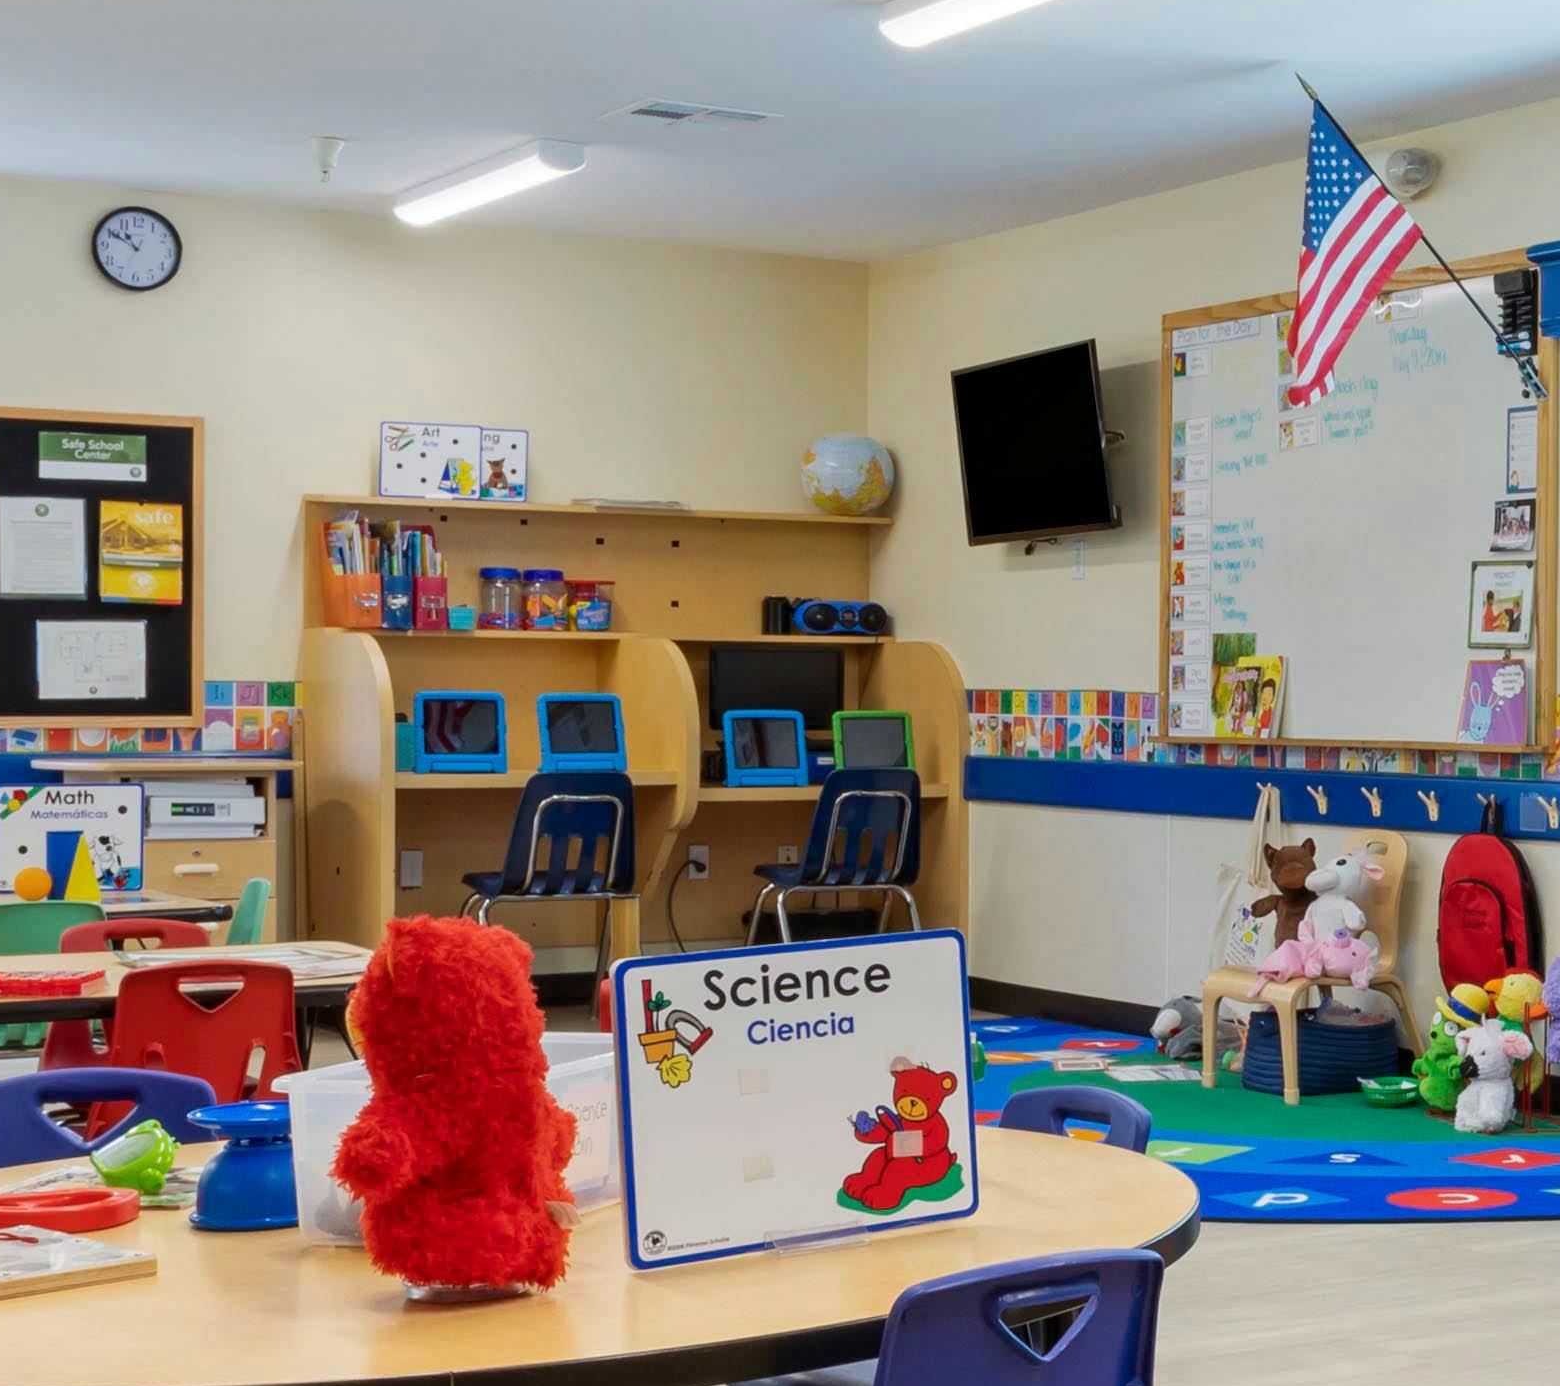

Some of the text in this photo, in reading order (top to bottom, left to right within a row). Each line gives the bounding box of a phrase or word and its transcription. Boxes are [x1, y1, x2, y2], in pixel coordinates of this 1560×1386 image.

[61, 438, 125, 451] Safe School
[74, 449, 112, 461] Center
[45, 789, 95, 805] Math
[30, 808, 109, 820] Matemáticas
[703, 963, 891, 1011] Science
[746, 1012, 856, 1045] Ciencia
